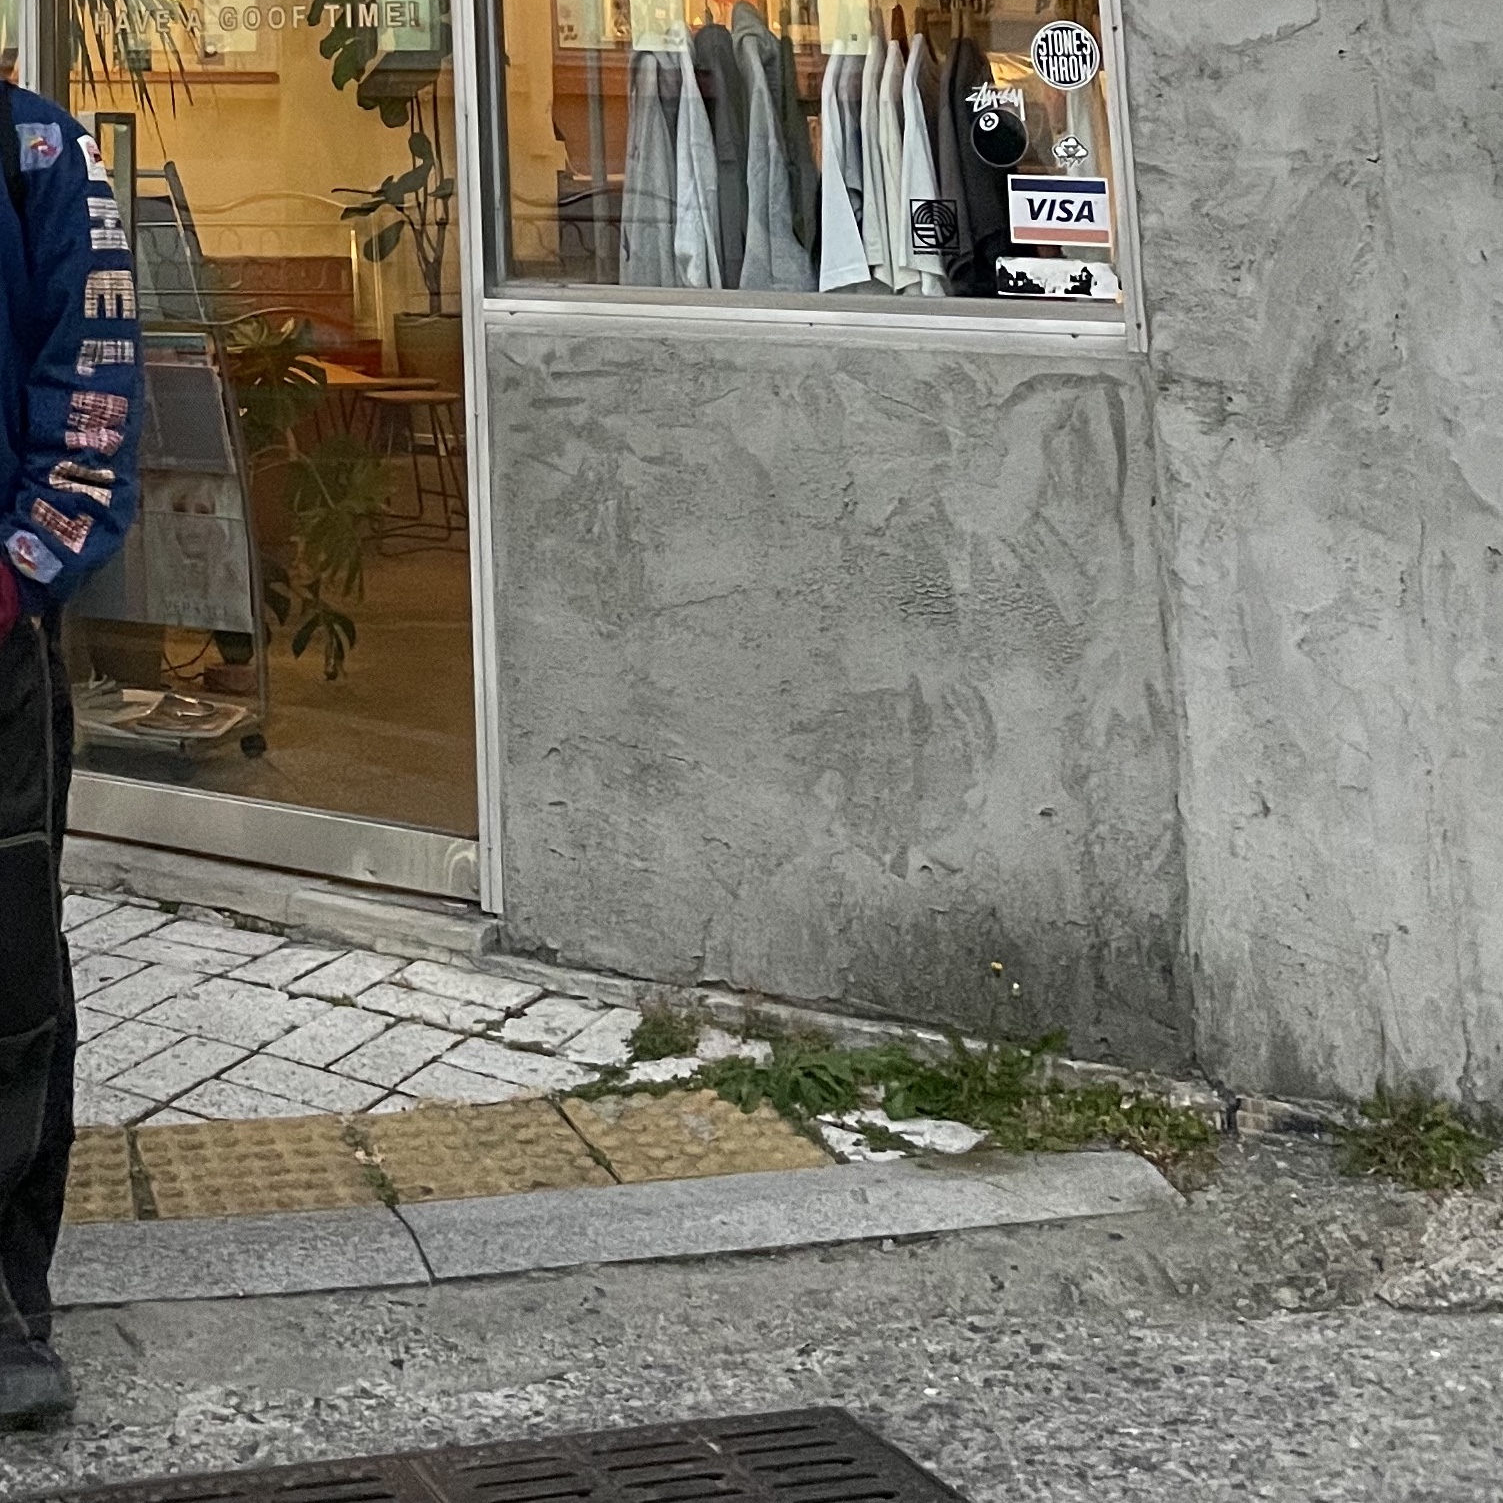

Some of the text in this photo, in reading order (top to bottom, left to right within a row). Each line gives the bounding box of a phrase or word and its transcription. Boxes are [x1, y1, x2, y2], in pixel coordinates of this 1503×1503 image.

[95, 0, 421, 36] HAVE A GOOF TIME!
[1038, 29, 1092, 56] STONES
[1040, 55, 1092, 82] THROW
[1025, 197, 1095, 223] VISA
